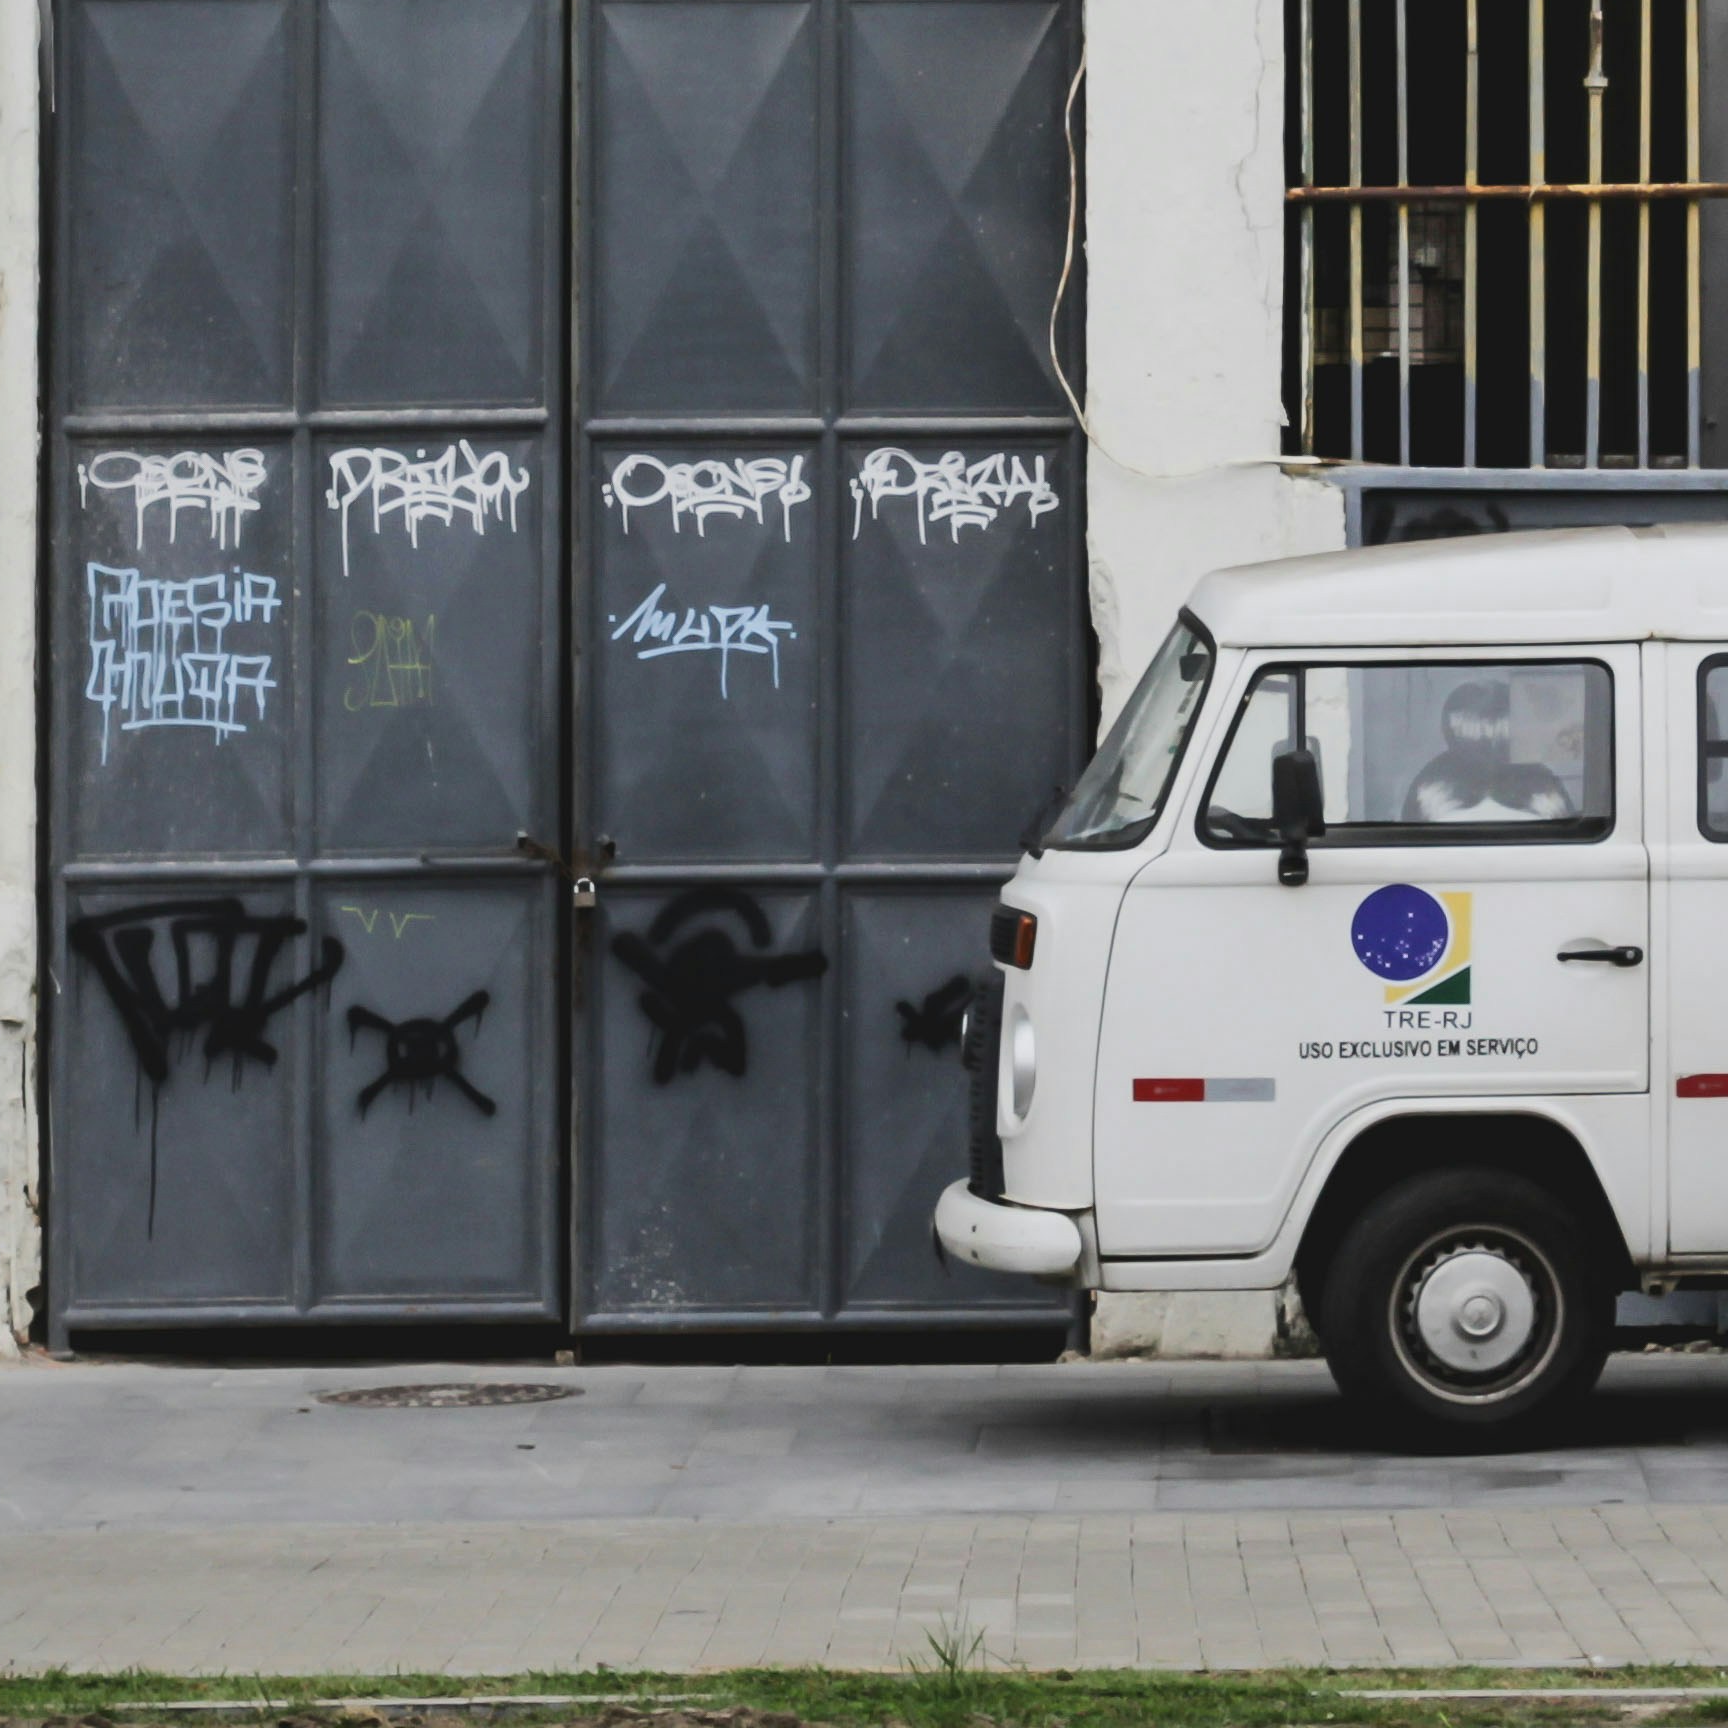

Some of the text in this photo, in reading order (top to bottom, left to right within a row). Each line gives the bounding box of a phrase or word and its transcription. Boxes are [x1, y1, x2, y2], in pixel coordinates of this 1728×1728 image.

[1383, 1010, 1472, 1029] TRE-RJ
[1299, 1037, 1539, 1059] USO EXCLUSIVO EM SERVIÇO
